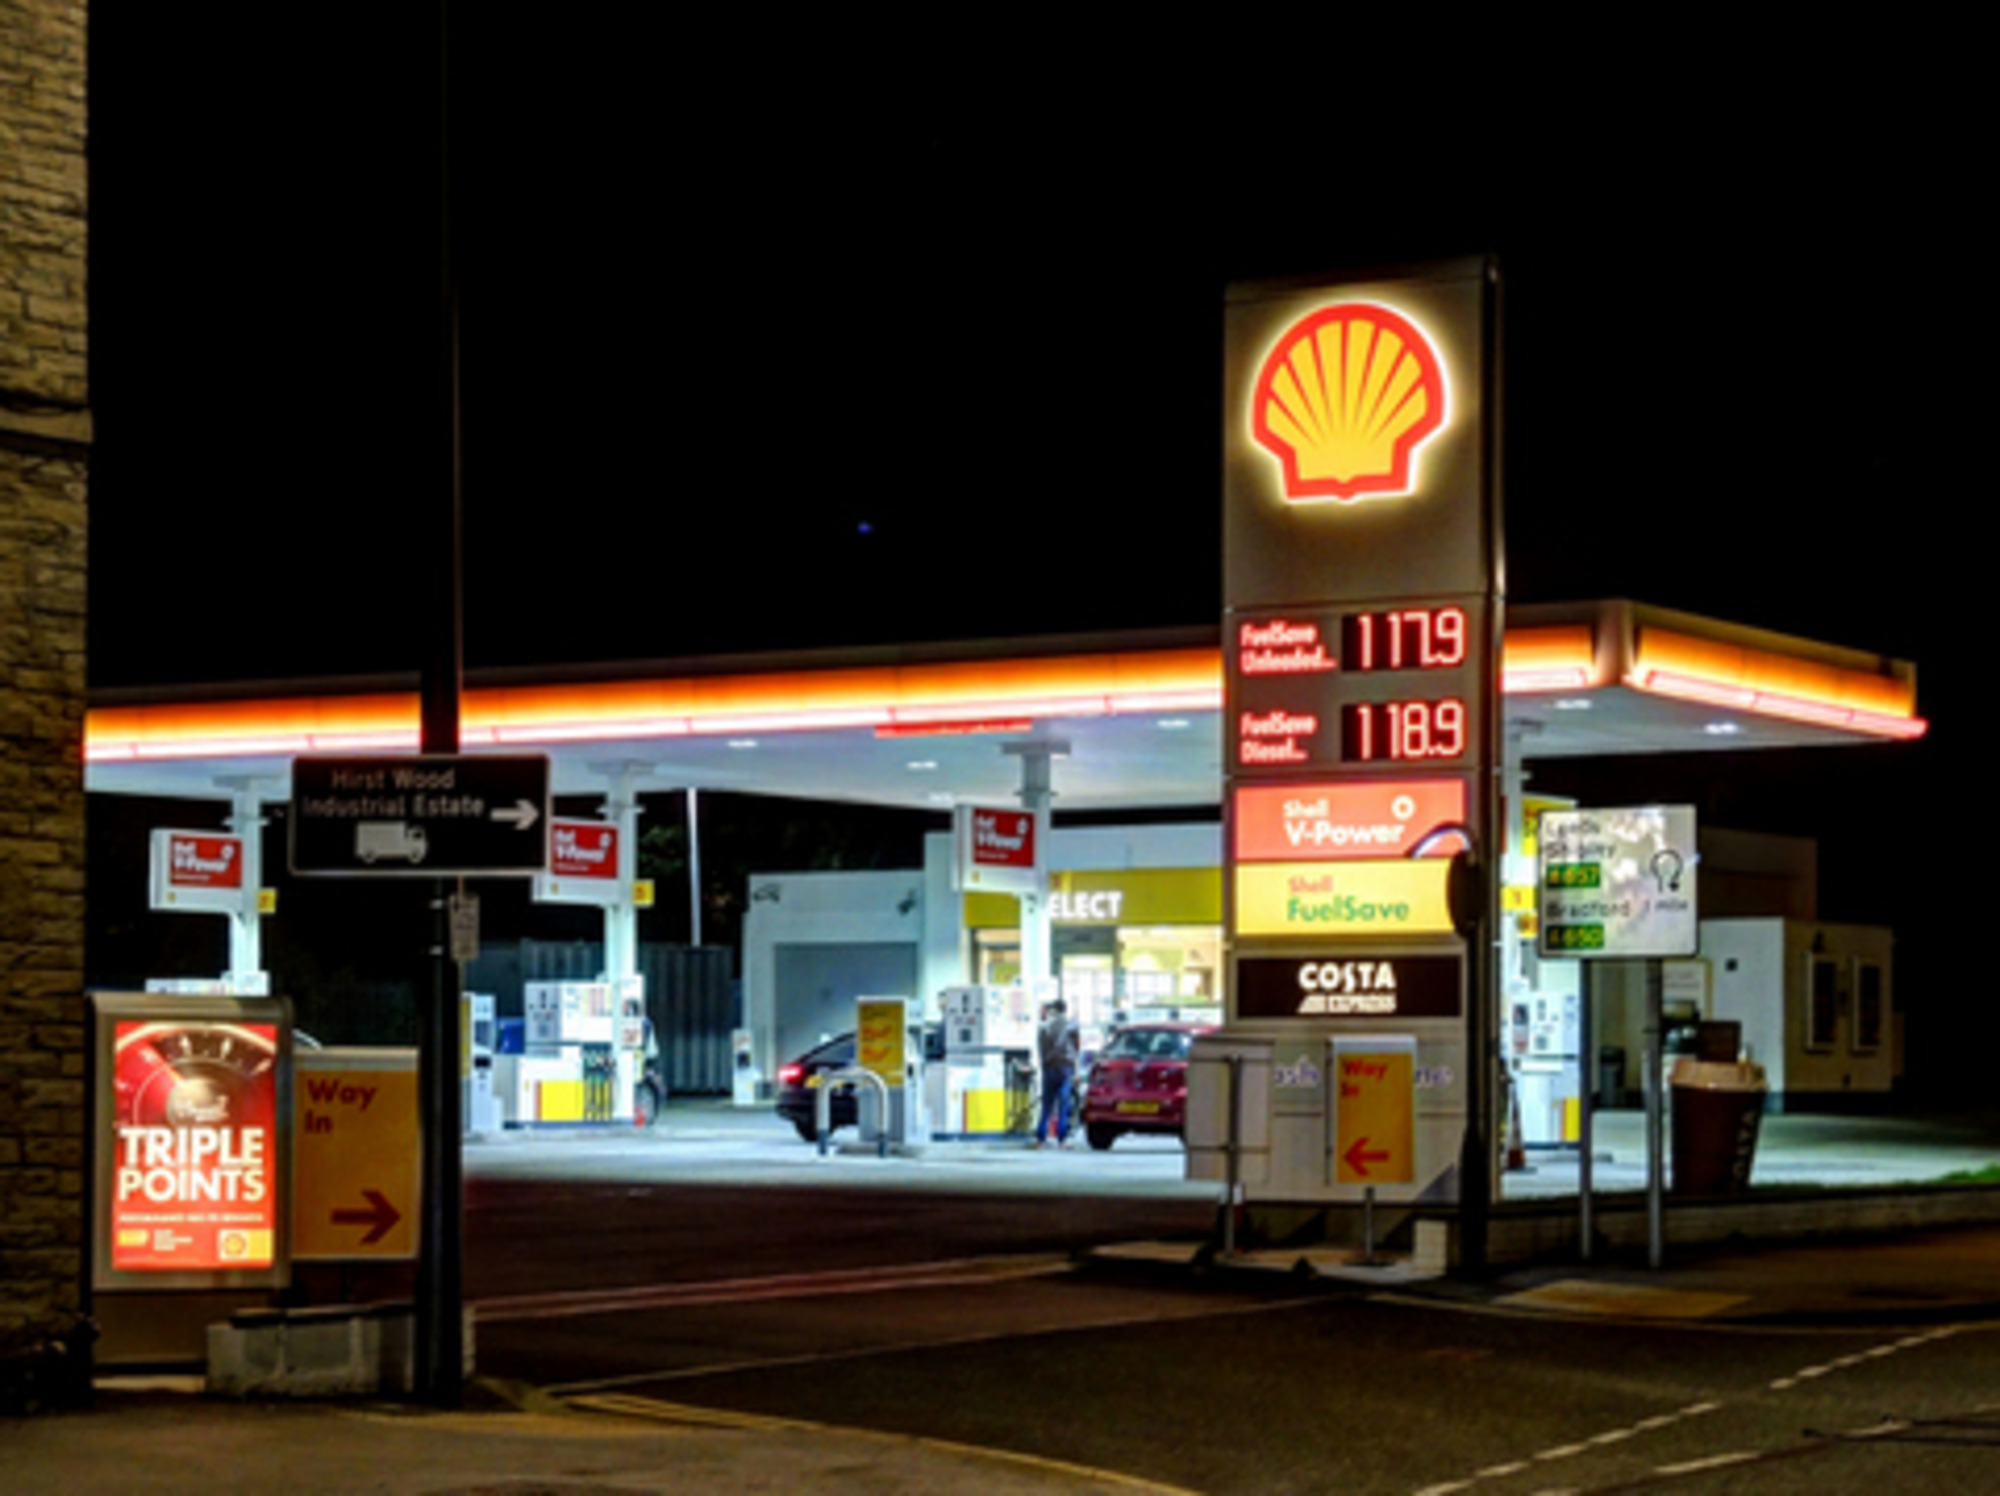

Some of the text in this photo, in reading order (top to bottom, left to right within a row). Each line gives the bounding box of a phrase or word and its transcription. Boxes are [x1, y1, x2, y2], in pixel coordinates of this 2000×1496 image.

[1358, 607, 1466, 669] 117.9
[1358, 698, 1466, 760] 118.9
[331, 767, 456, 790] Hirst Wood
[302, 795, 486, 817] Industrial Estate
[1283, 798, 1330, 818] Shell
[1284, 820, 1406, 846] V-Power
[1287, 876, 1334, 893] Shell
[1049, 890, 1123, 919] ELECT
[1286, 896, 1410, 922] FuelSave
[1298, 961, 1397, 992] COSTA
[1343, 1058, 1389, 1082] Way
[305, 1078, 378, 1111] Way
[1341, 1082, 1361, 1098] In
[304, 1110, 334, 1134] In
[119, 1127, 265, 1167] TRIPLE
[118, 1168, 266, 1203] POINTS
